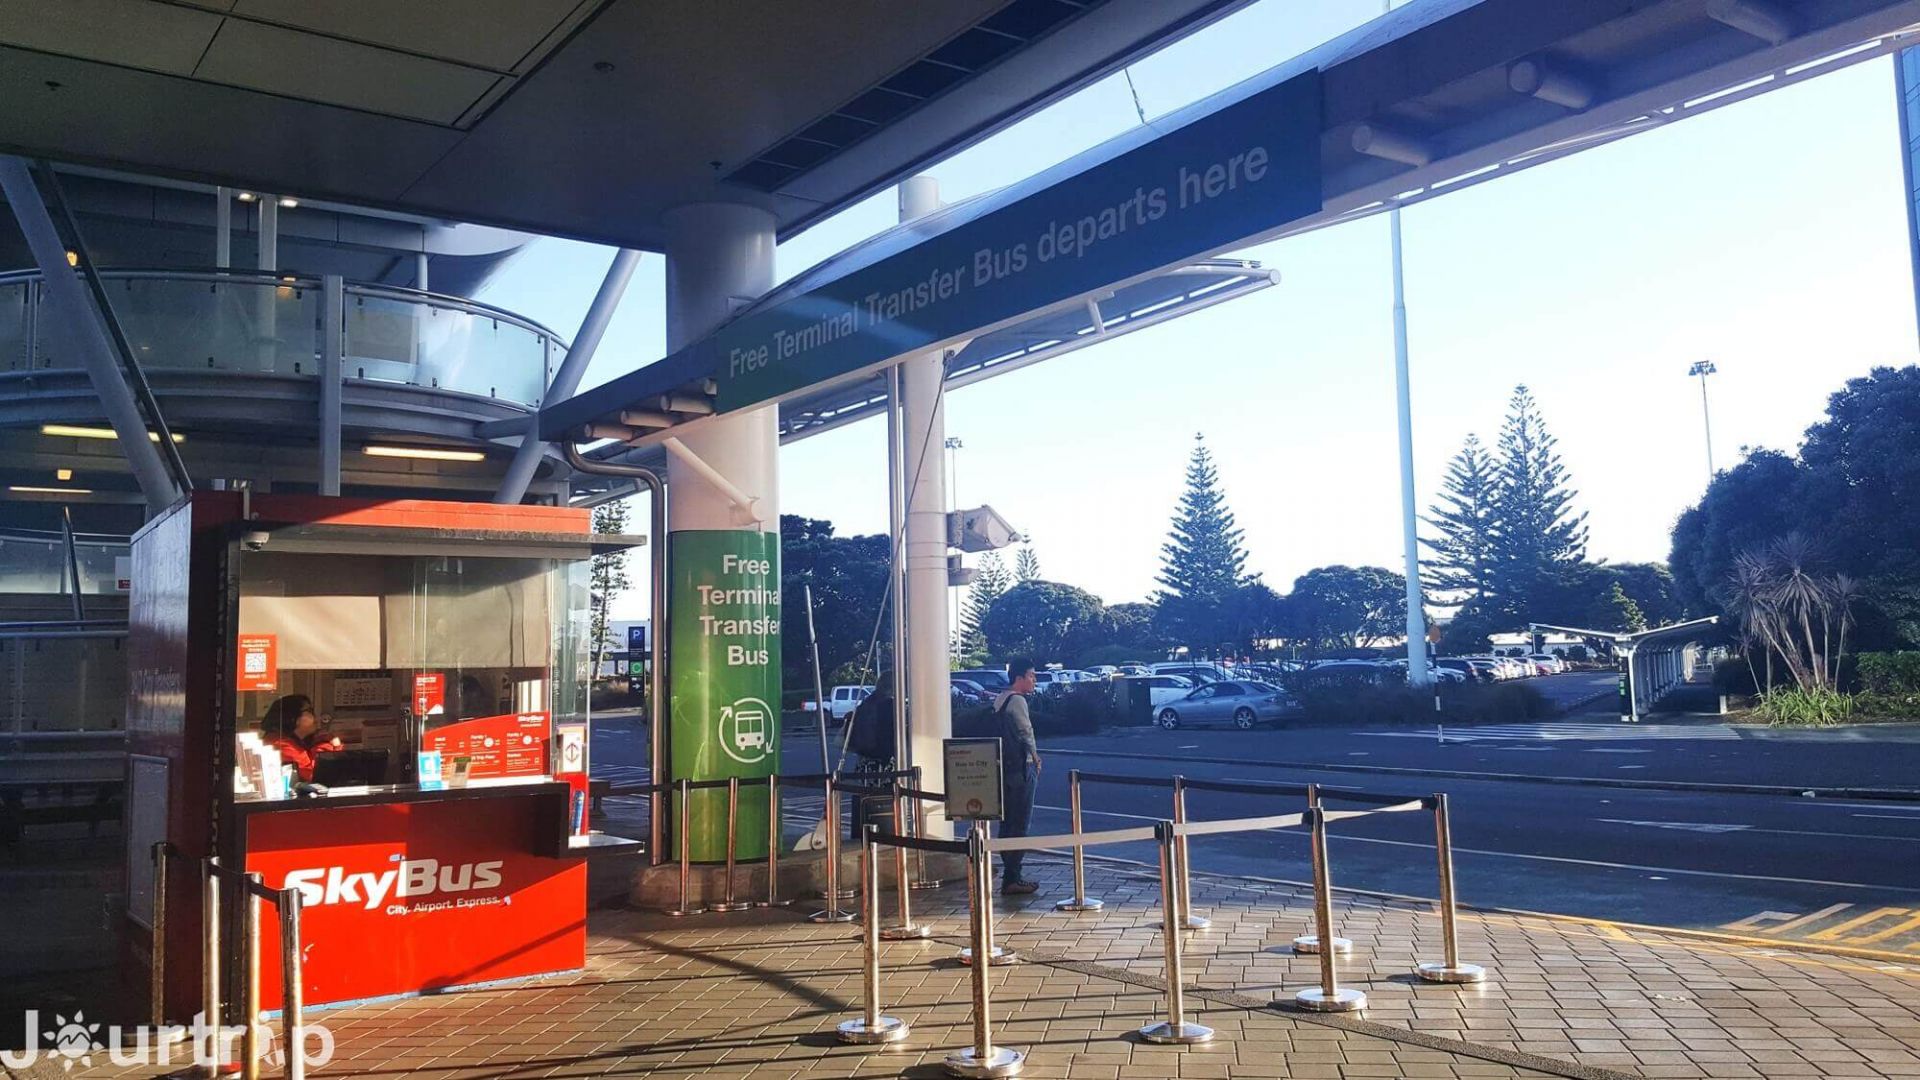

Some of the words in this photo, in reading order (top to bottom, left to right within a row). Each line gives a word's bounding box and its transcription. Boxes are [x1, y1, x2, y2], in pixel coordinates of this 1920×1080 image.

[730, 345, 769, 379] Free
[774, 302, 859, 361] Terminal
[865, 265, 966, 327] Transfer
[973, 243, 1028, 288] Bus
[1038, 186, 1168, 259] departs
[1178, 146, 1269, 209] here
[723, 554, 770, 575] Free
[697, 585, 781, 606] Termina
[728, 645, 769, 666] Bus
[284, 858, 504, 910] SkyBus
[386, 904, 411, 915] City.
[413, 901, 454, 913] Airport.
[456, 896, 501, 908] Express.
